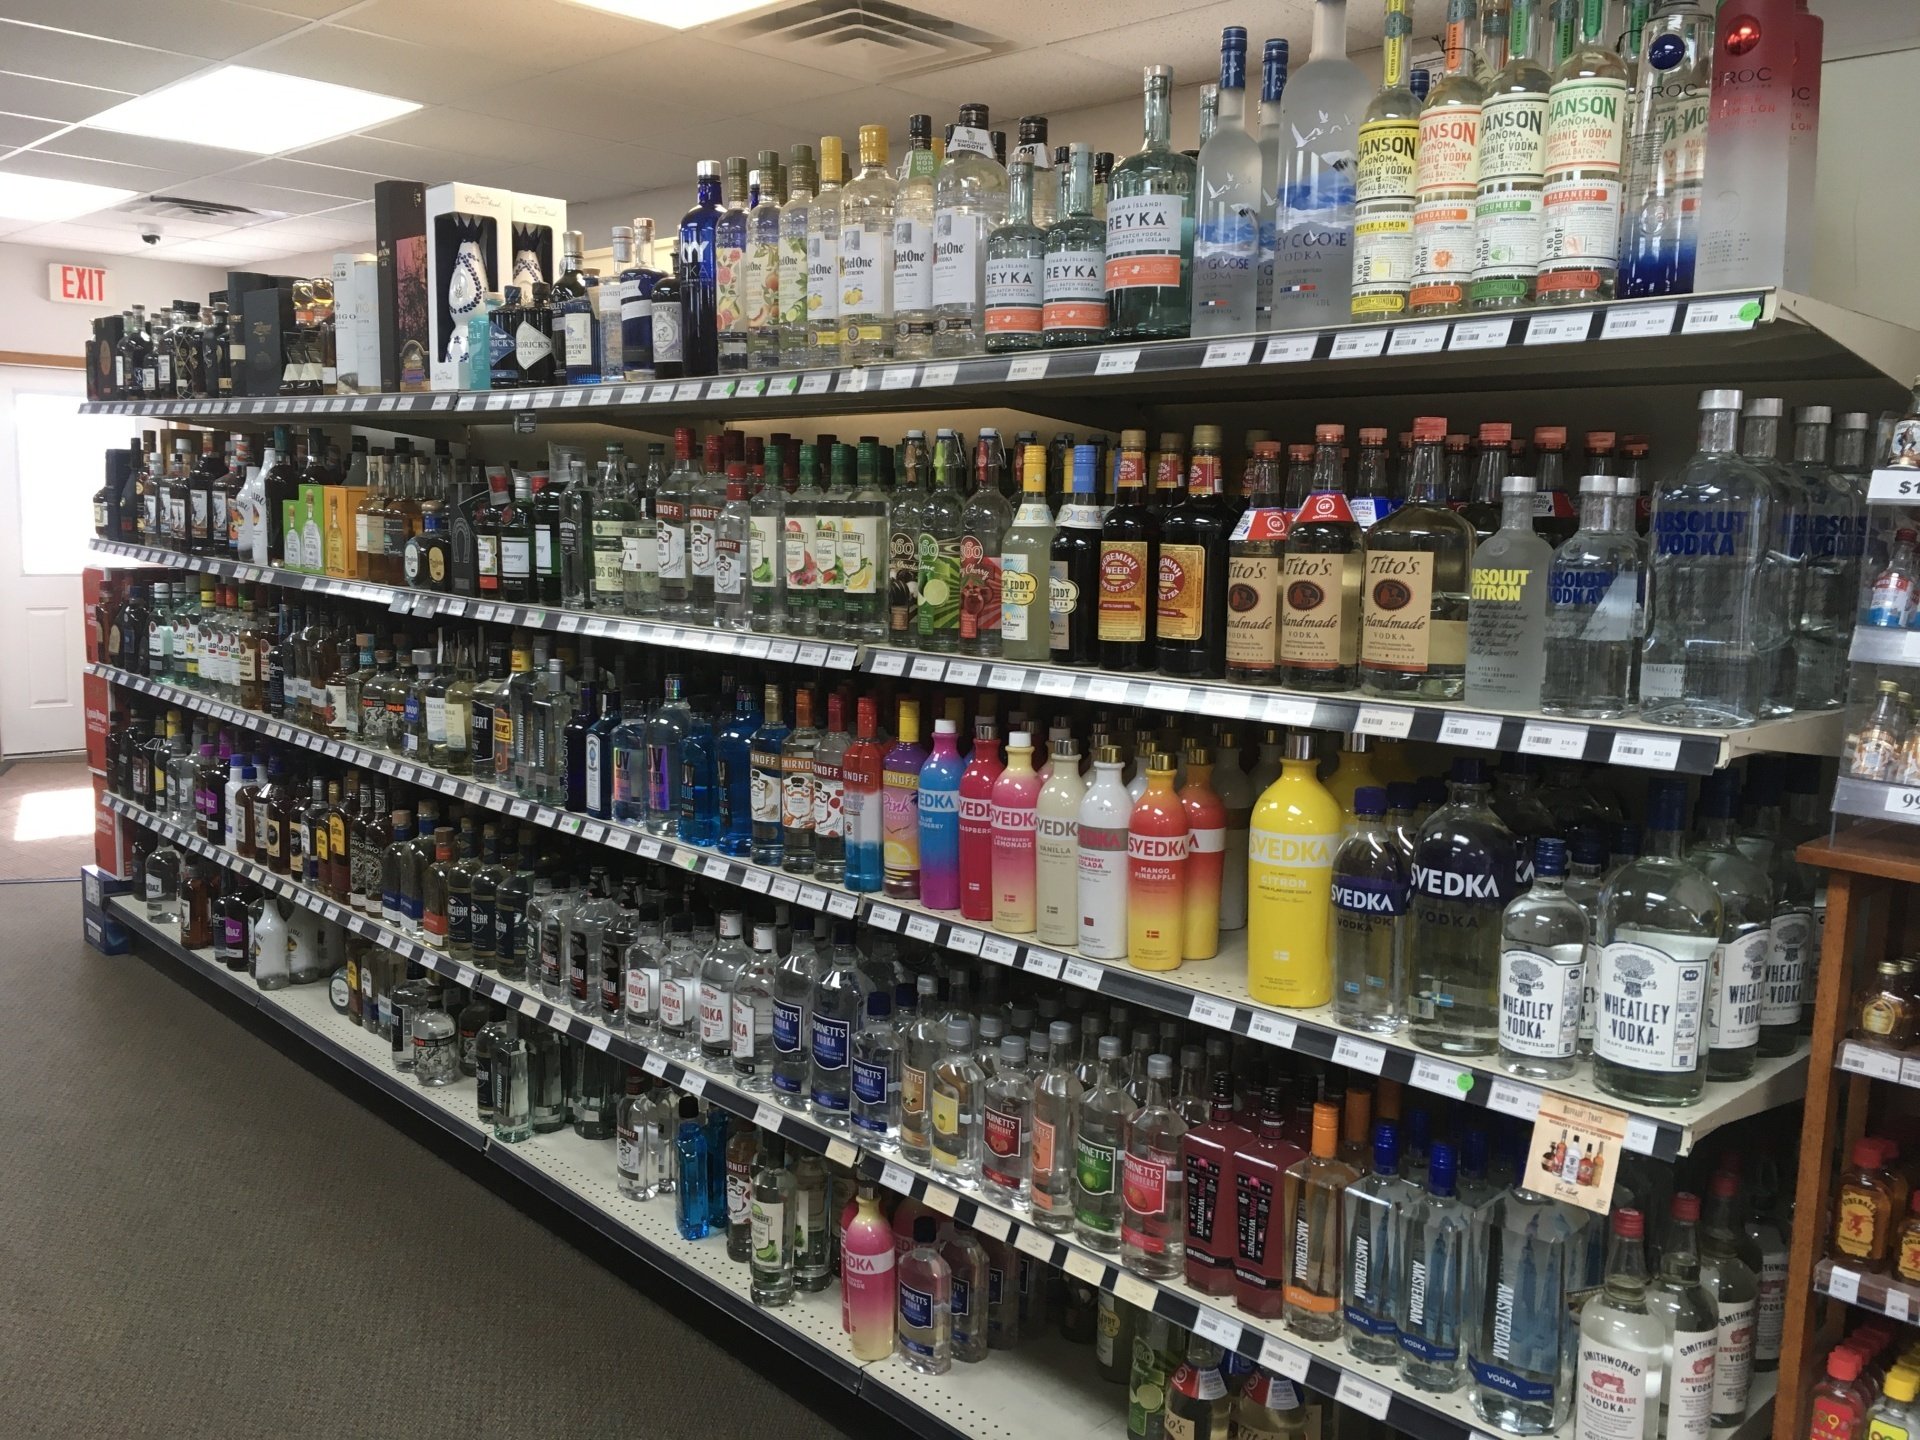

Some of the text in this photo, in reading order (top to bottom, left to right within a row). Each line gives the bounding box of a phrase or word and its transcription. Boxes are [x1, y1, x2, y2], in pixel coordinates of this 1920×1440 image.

[1557, 116, 1597, 128] SONOMA
[1420, 121, 1476, 147] ANSON
[1486, 130, 1523, 142] SONOMA
[1582, 128, 1612, 139] VODKA
[957, 142, 985, 151] SMOOTH
[1508, 141, 1538, 151] VODKA
[1364, 154, 1398, 166] SONOMA
[1443, 152, 1472, 162] VODKA
[1386, 165, 1413, 176] VODKA
[1108, 211, 1166, 231] REYKA
[1380, 220, 1406, 230] LEMON
[947, 241, 965, 254] One
[1554, 227, 1563, 259] PROOF
[906, 249, 927, 263] One
[1419, 245, 1428, 275] PROOF
[1481, 237, 1490, 269] PROOF
[855, 257, 875, 269] One
[1363, 254, 1371, 283] PROOF
[986, 271, 1032, 286] REYKA
[1046, 265, 1097, 280] REYKA
[61, 265, 106, 302] EXIT
[1271, 520, 1281, 528] GF
[1654, 510, 1748, 534] ABSOLUT
[1657, 533, 1736, 556] VODKA
[1101, 552, 1139, 571] JEREMIAH
[1159, 557, 1183, 577] EMIAH
[1286, 555, 1333, 577] Tito's
[1370, 552, 1421, 576] Tito's
[1105, 566, 1130, 576] WEED
[1160, 572, 1175, 582] EED
[1471, 568, 1530, 586] ABSOLUT
[1010, 580, 1031, 591] EDDY
[1052, 587, 1071, 598] EDDY
[1120, 581, 1137, 592] TEA
[1471, 585, 1521, 602] CITRON
[1228, 615, 1273, 631] andmade
[1282, 613, 1338, 630] Handmade
[1365, 614, 1426, 631] Handmade
[1288, 631, 1320, 640] VODKA
[1373, 631, 1406, 641] VODKA
[615, 749, 630, 770] UV
[919, 793, 955, 809] EDKA
[1039, 846, 1072, 855] VANILLA
[1128, 838, 1186, 858] SVEDKA
[1250, 834, 1331, 863] SVEDKA
[1134, 872, 1177, 881] PINEAPPLE
[1140, 866, 1170, 874] MANGO
[1260, 875, 1307, 888] CITRON
[1410, 861, 1500, 899] SVEDKA
[1331, 883, 1395, 912] SVEDKA
[1336, 917, 1374, 933] VODKA
[1417, 908, 1480, 929] VODKA
[628, 983, 647, 998] VODKA
[661, 994, 681, 1010] VODKA
[1502, 991, 1554, 1021] WHEATLEY
[1603, 991, 1671, 1025] WHEATLEY
[1507, 1019, 1543, 1040] VODKA
[1611, 1019, 1656, 1047] VODKA
[816, 1032, 836, 1048] VODKA
[1624, 1044, 1666, 1056] DISTILLED
[857, 1074, 875, 1088] VODKA
[1084, 1156, 1097, 1167] LIME
[1197, 1198, 1205, 1238] WHITNEY
[1247, 1219, 1256, 1259] WHITNEY
[1296, 1219, 1310, 1281] AMSTERDAM
[1354, 1235, 1369, 1300] AMSTERDAM
[1409, 1259, 1425, 1326] AMSTERDAM
[1348, 1310, 1369, 1326] VODKA
[1492, 1282, 1515, 1361] AMSTERDAM
[1403, 1337, 1427, 1353] VODKA
[1583, 1350, 1641, 1377] SMITHWORKS
[1486, 1371, 1518, 1391] VODKA
[1590, 1396, 1625, 1414] VODKA
[1616, 1396, 1637, 1405] MADE
